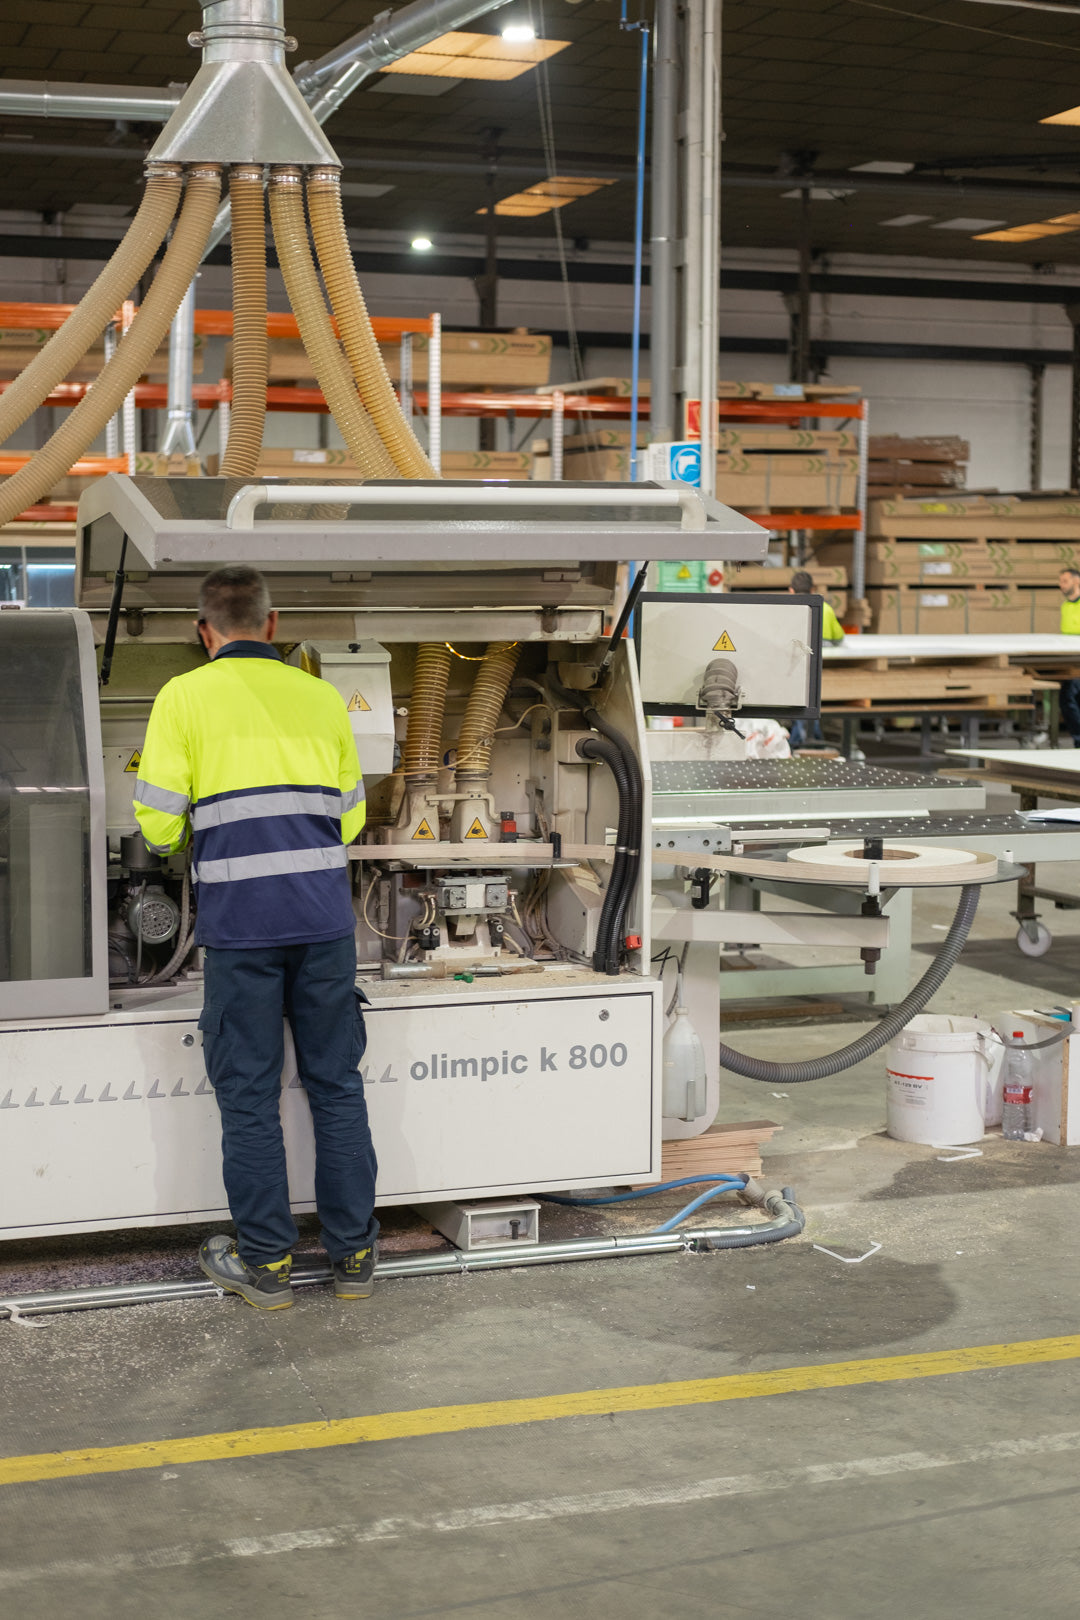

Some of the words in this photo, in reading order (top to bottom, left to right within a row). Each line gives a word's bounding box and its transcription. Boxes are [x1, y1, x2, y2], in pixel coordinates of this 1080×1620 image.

[410, 1050, 528, 1081] olimpic
[540, 1047, 558, 1071] k
[568, 1042, 628, 1069] 800
